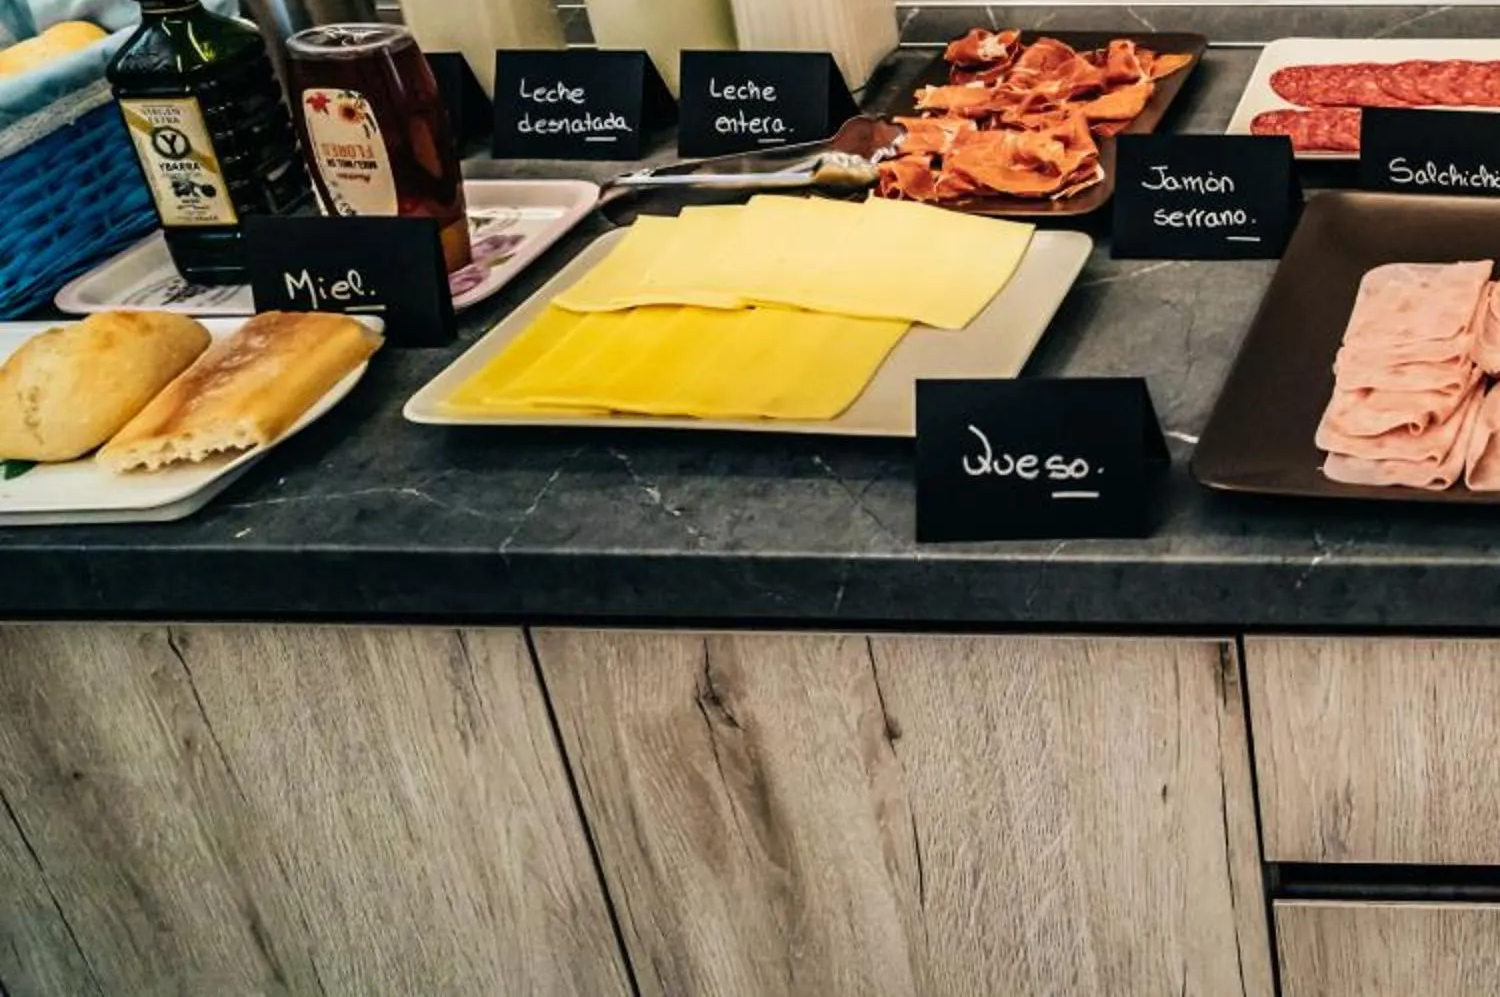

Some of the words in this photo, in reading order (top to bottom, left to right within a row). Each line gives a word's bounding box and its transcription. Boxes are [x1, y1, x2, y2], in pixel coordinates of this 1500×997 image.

[520, 77, 586, 104] Leche
[709, 77, 777, 102] Leche
[1153, 206, 1258, 228] serrano.
[283, 268, 376, 310] Miel.
[962, 423, 1105, 480] Queso.
